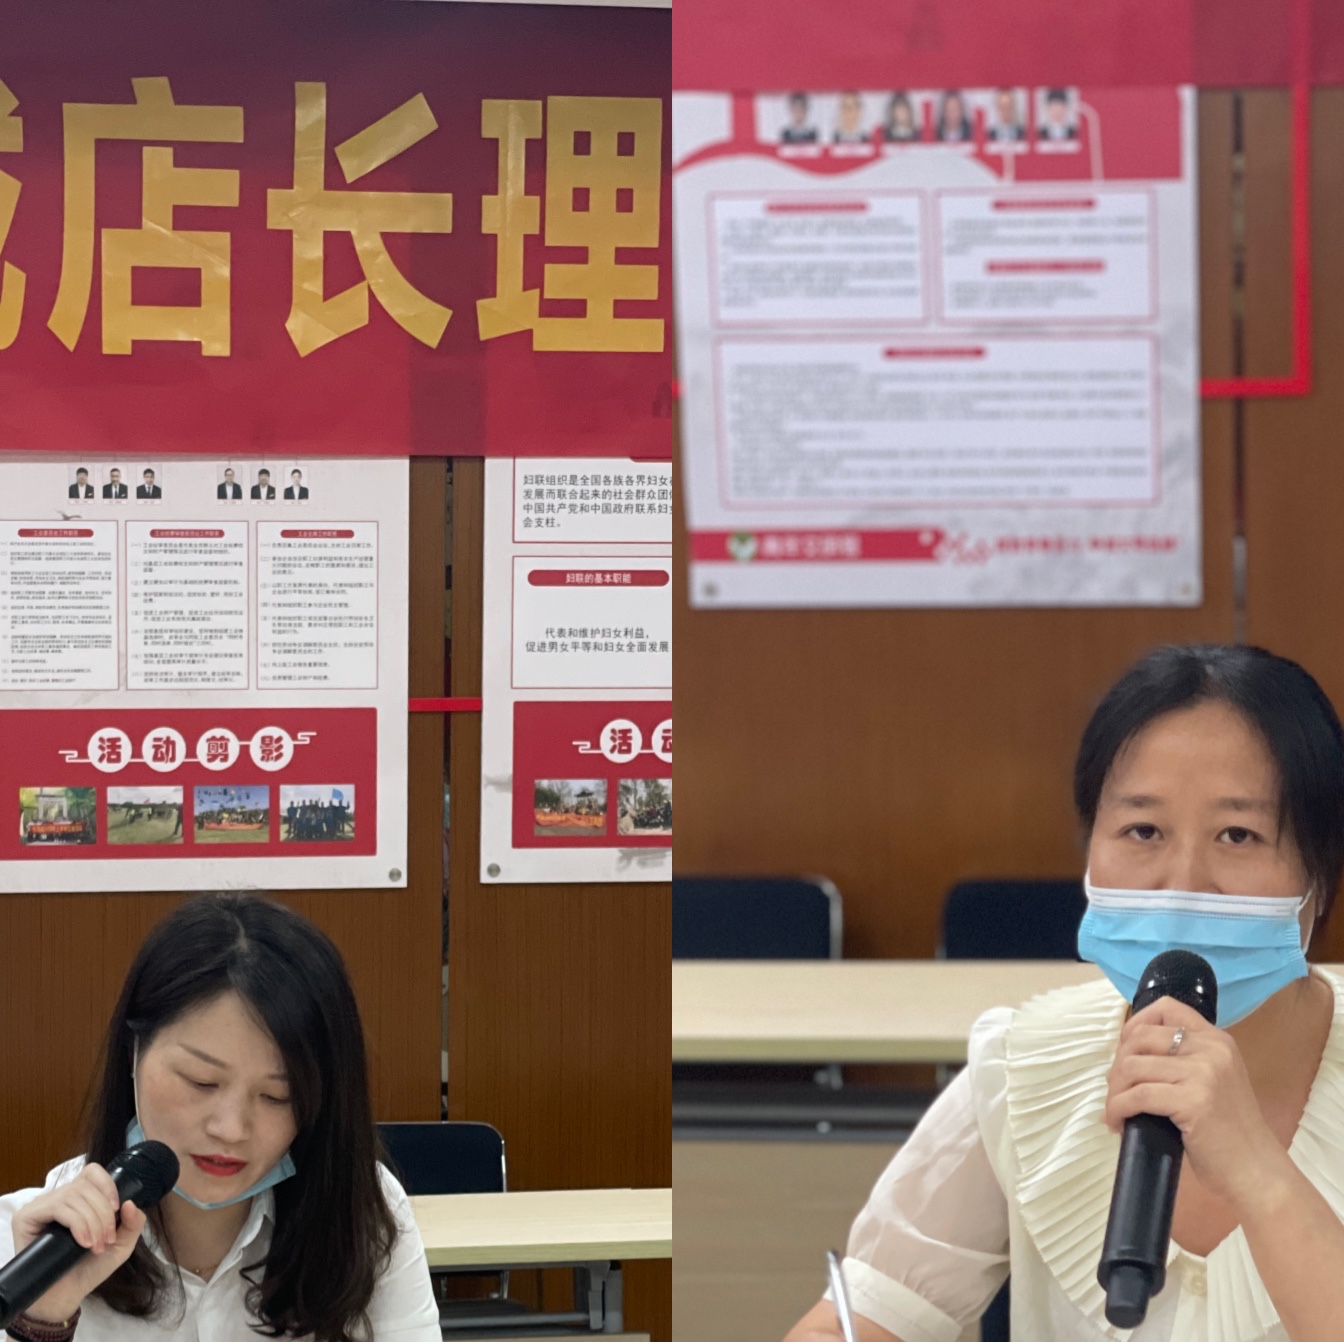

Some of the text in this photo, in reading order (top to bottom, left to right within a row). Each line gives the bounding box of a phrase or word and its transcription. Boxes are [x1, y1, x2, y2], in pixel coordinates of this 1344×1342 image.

[565, 572, 632, 585] 妇联的基本职能
[97, 735, 284, 764] 活动剪影
